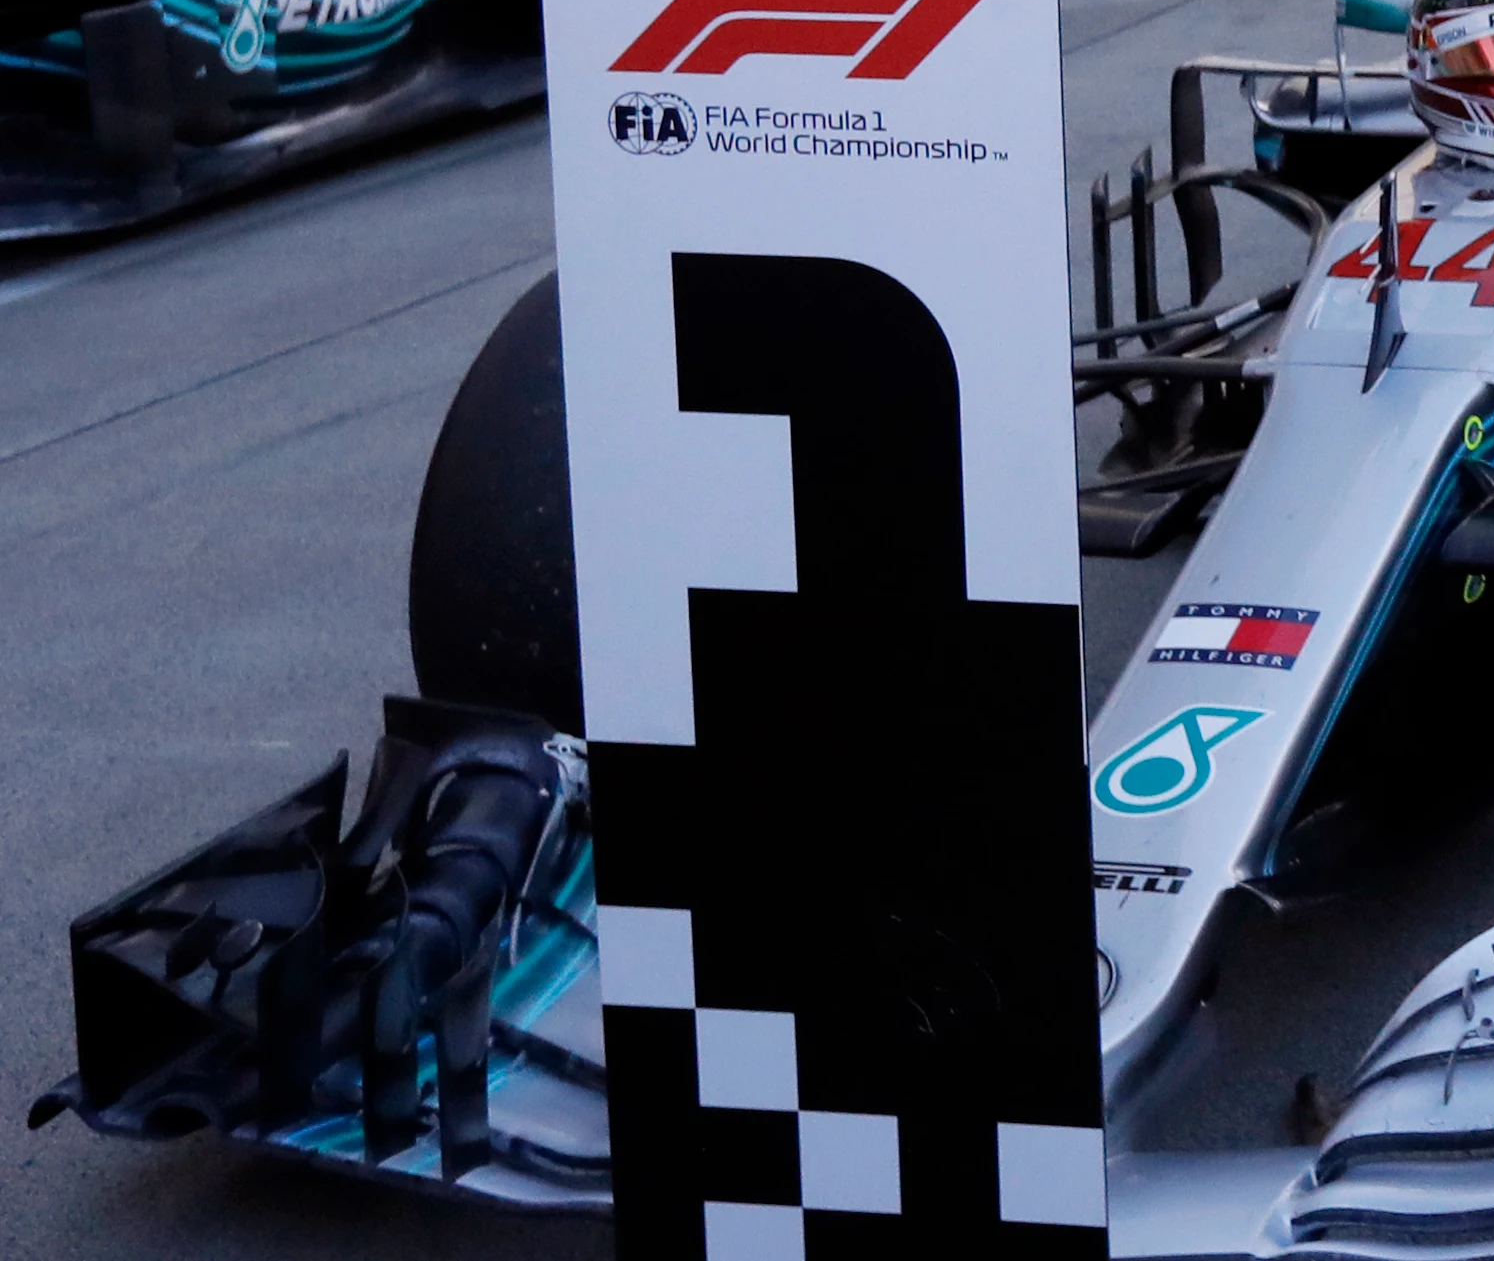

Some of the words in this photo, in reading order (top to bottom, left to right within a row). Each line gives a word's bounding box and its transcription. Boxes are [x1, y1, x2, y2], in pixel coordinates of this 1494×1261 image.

[705, 106, 750, 128] FIA
[756, 107, 867, 132] Formula
[872, 110, 888, 132] 1
[705, 131, 787, 155] World
[793, 134, 988, 163] Championship
[1186, 604, 1310, 622] TOMMY
[1158, 648, 1286, 667] HILFIGER
